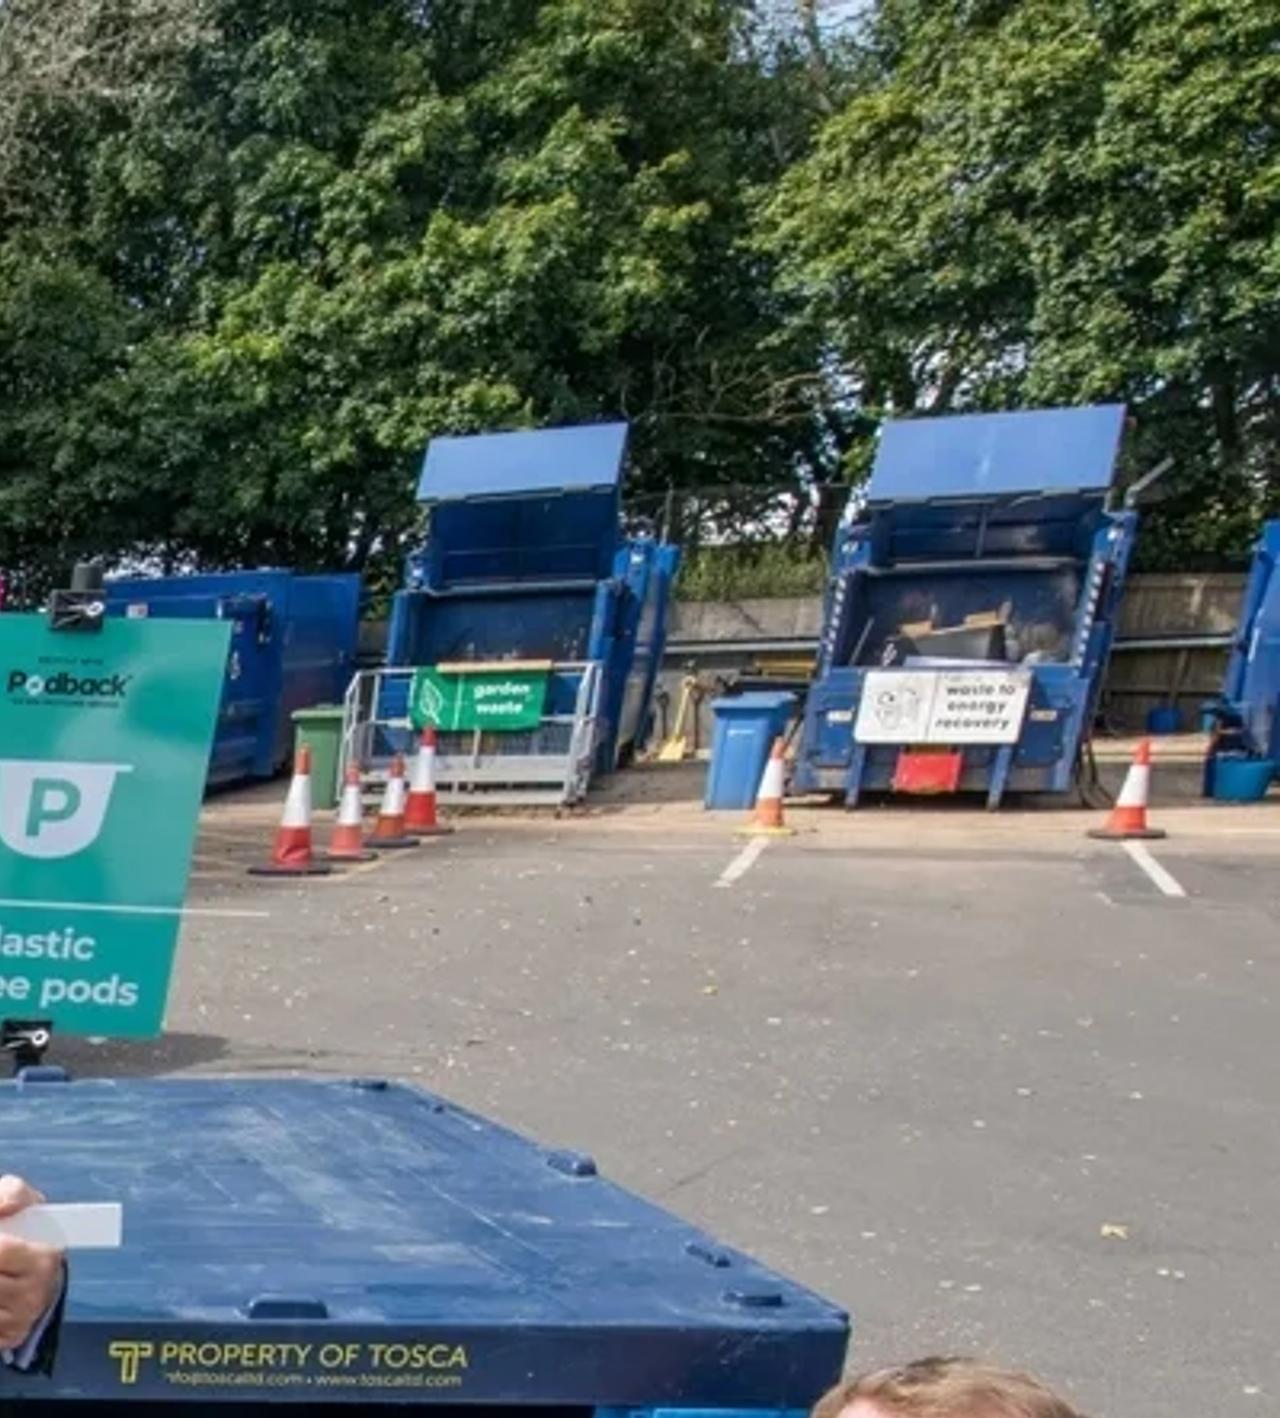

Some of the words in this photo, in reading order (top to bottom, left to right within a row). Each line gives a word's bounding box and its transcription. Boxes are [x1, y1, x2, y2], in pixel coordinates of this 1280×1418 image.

[473, 681, 530, 699] garden
[947, 684, 995, 696] waste
[476, 701, 523, 715] waste
[947, 701, 1007, 716] energy
[935, 718, 1009, 731] recovery
[25, 777, 82, 837] P
[40, 973, 140, 1009] pods
[160, 1341, 313, 1367] PROPERTY
[319, 1343, 361, 1368] OF
[367, 1343, 469, 1369] TOSCA
